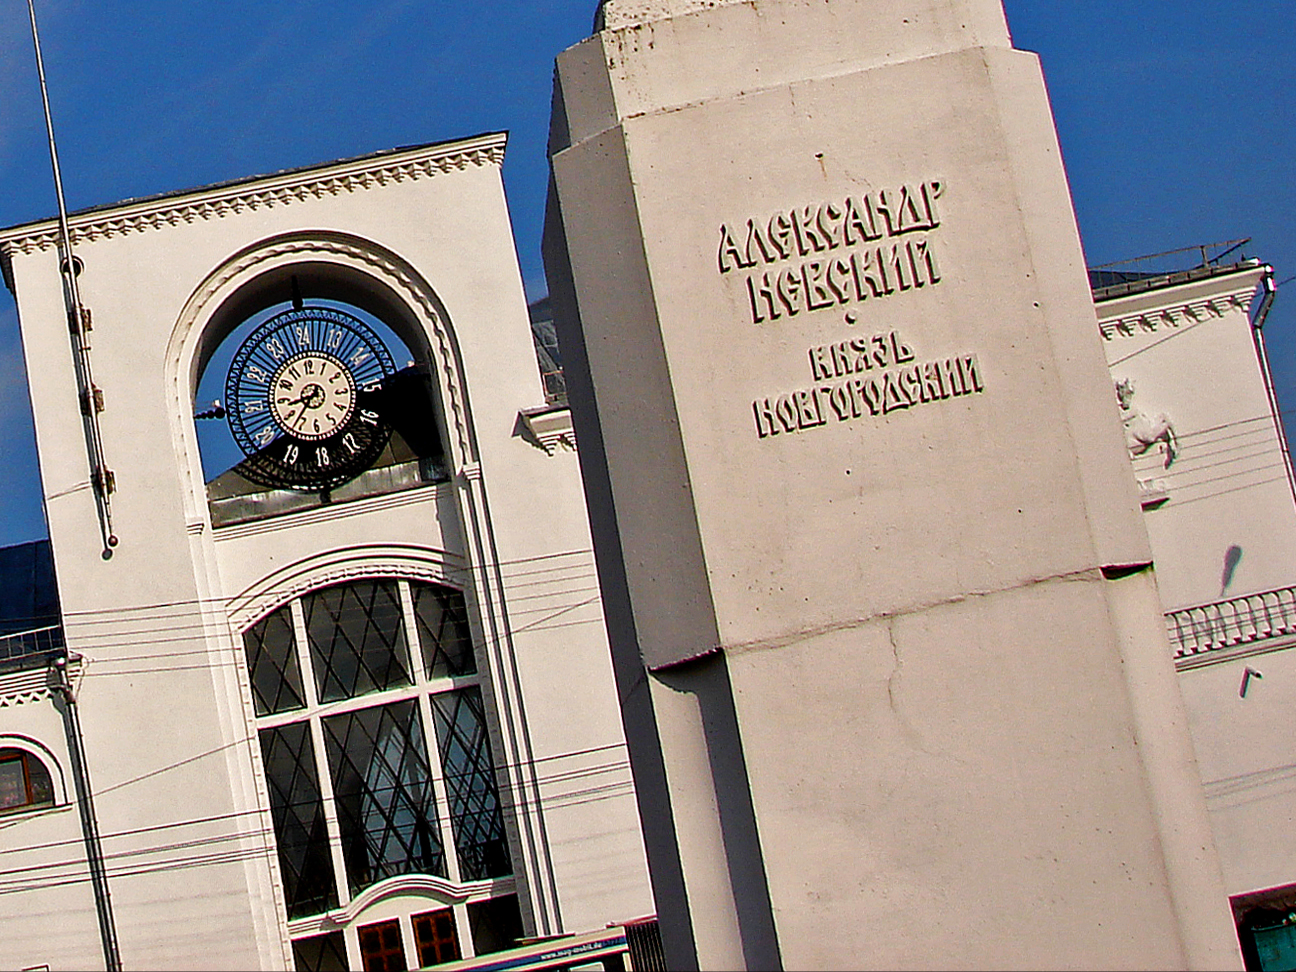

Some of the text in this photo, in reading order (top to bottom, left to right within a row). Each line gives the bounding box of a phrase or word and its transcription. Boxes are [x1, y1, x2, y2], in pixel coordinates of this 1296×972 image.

[717, 180, 946, 274] АЛЕКСАНДР
[746, 240, 942, 324] НЕВСКИЙ
[296, 327, 311, 346] 24
[327, 329, 342, 348] 13
[266, 339, 285, 359] 23
[350, 347, 371, 365] 14
[808, 330, 915, 382] КНЯЗЬ
[247, 366, 267, 383] 22
[288, 366, 301, 380] 11
[303, 360, 314, 375] 12
[320, 362, 327, 375] 1
[279, 379, 293, 391] 10
[329, 372, 341, 384] 2
[362, 378, 382, 392] 15
[751, 355, 986, 439] НОВГОРОДСКИЙ
[245, 400, 263, 413] 21
[333, 402, 347, 411] 4
[284, 410, 295, 421] 8
[299, 417, 306, 431] 7
[326, 413, 336, 426] 5
[360, 409, 379, 426] 16
[314, 419, 320, 433] 6
[255, 426, 275, 445] 20
[342, 432, 360, 455] 17
[283, 444, 299, 465] 19
[315, 446, 330, 467] 18
